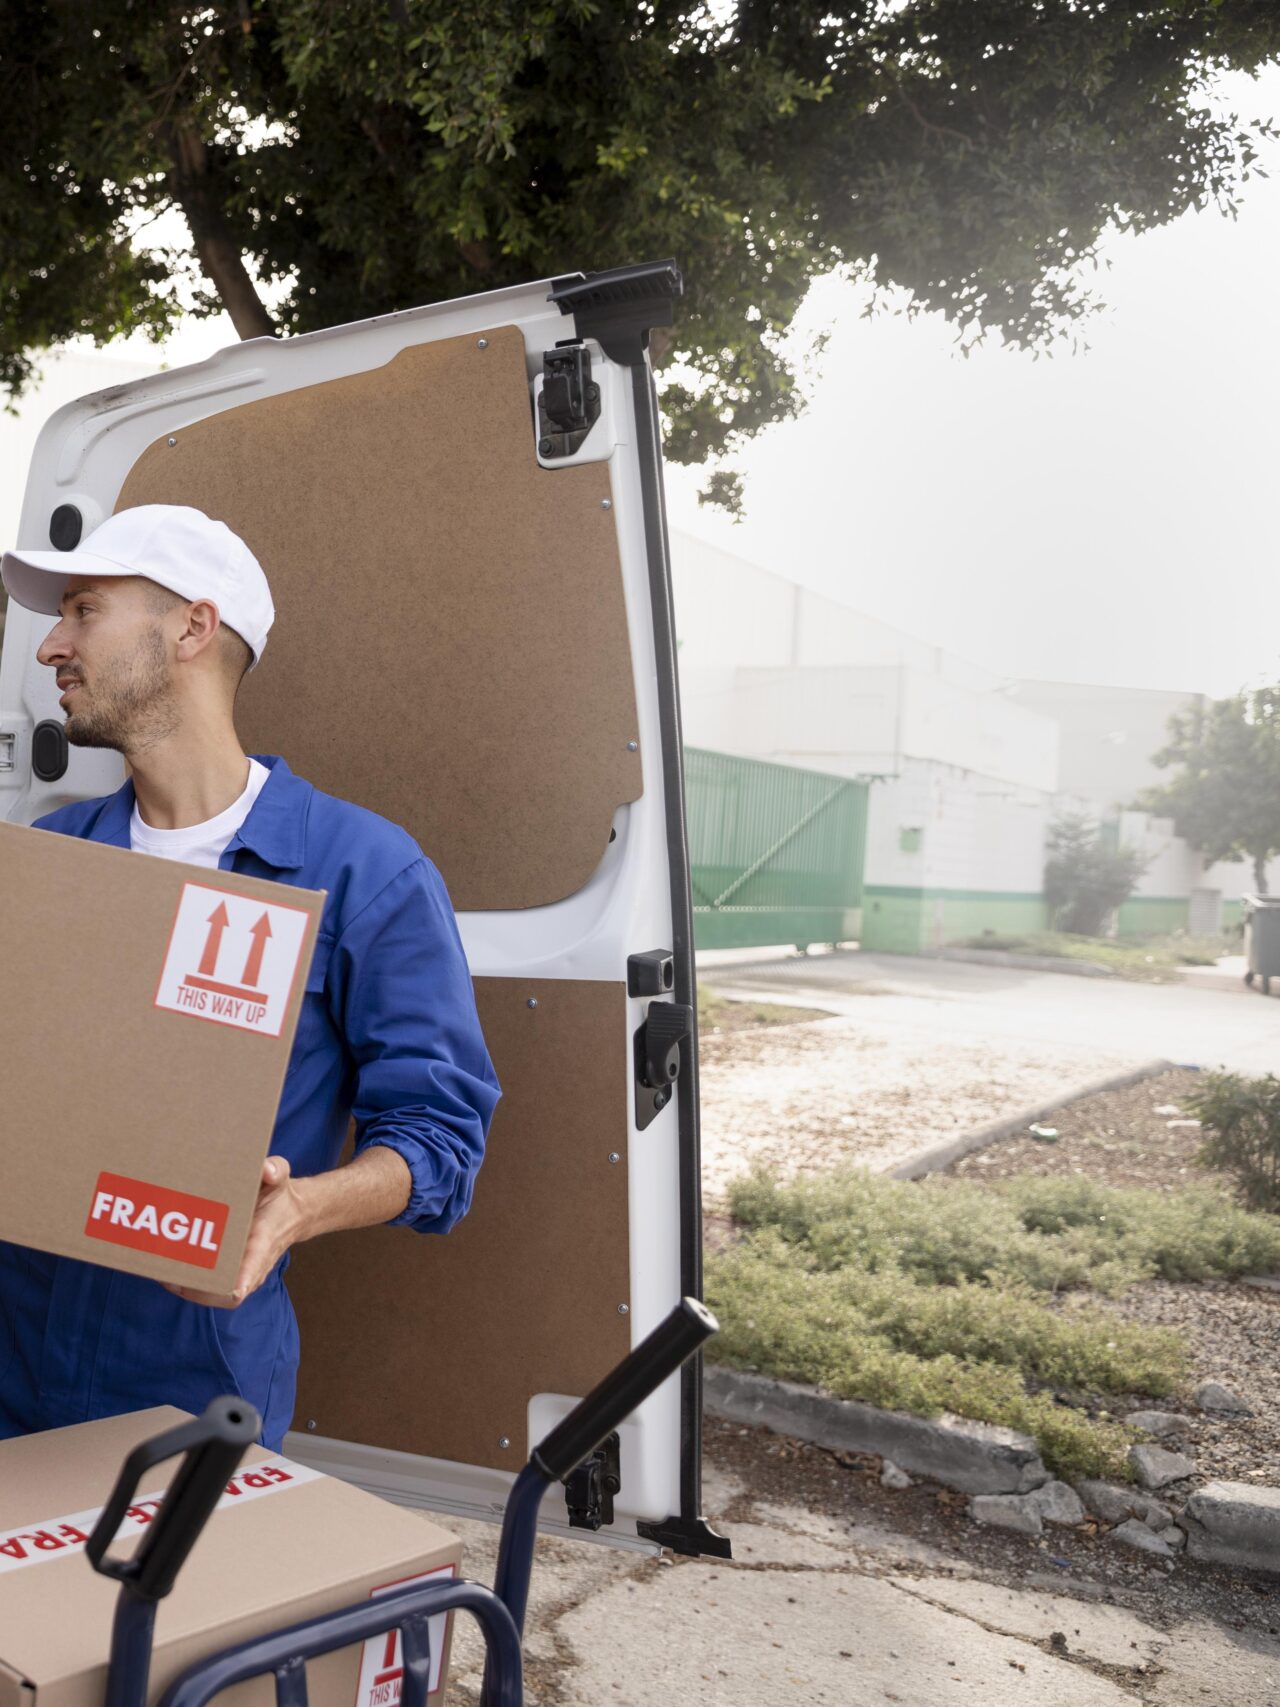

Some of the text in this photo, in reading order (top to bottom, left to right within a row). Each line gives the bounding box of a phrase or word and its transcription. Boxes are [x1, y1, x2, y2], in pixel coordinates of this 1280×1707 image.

[176, 986, 266, 1024] THIS WAY UP
[91, 1191, 218, 1251] FRAGIL
